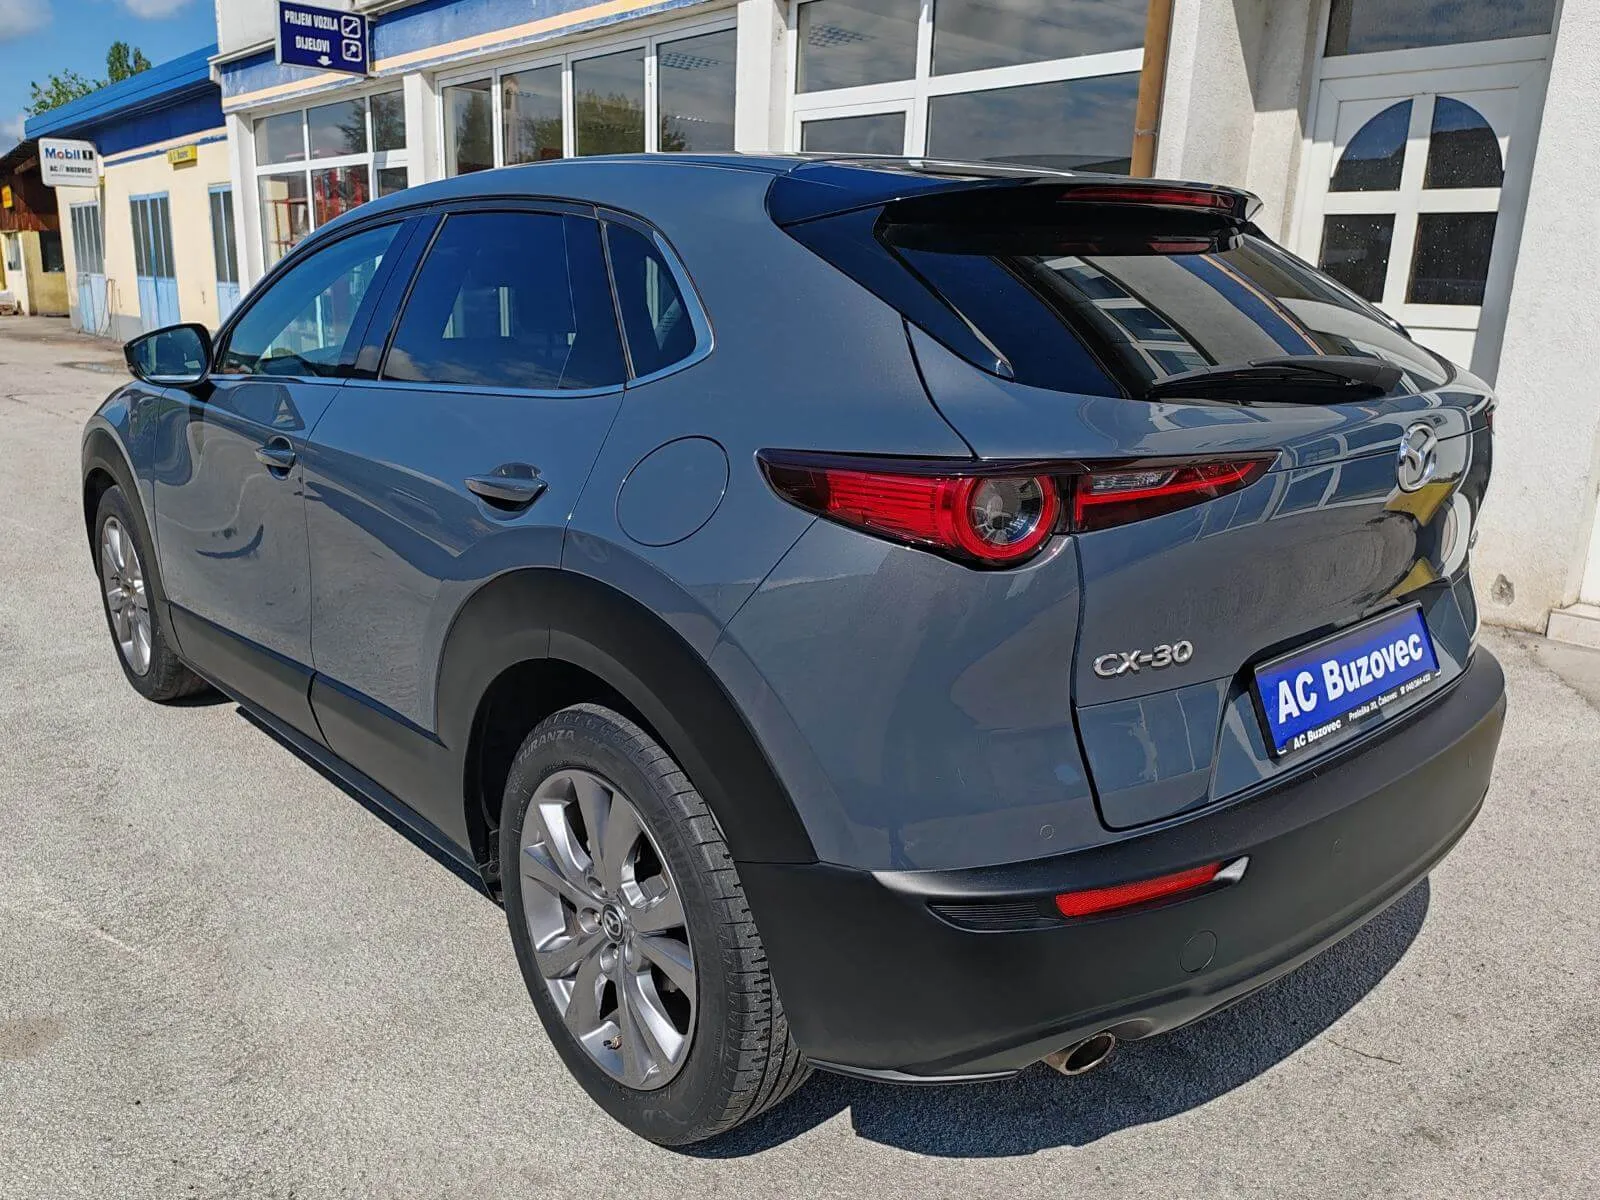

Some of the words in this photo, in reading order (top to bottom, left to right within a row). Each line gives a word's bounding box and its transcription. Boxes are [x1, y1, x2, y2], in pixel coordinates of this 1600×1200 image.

[284, 10, 313, 27] PRIJEM
[313, 14, 339, 31] VOZILA
[295, 36, 330, 53] DIJELOVI
[45, 147, 80, 160] Mobil
[1092, 640, 1194, 677] CX-30
[1278, 671, 1318, 725] AC
[1321, 633, 1423, 702] Buzovec
[518, 729, 575, 764] TURANZA
[1293, 733, 1307, 750] AC
[1307, 719, 1342, 743] Buzovec
